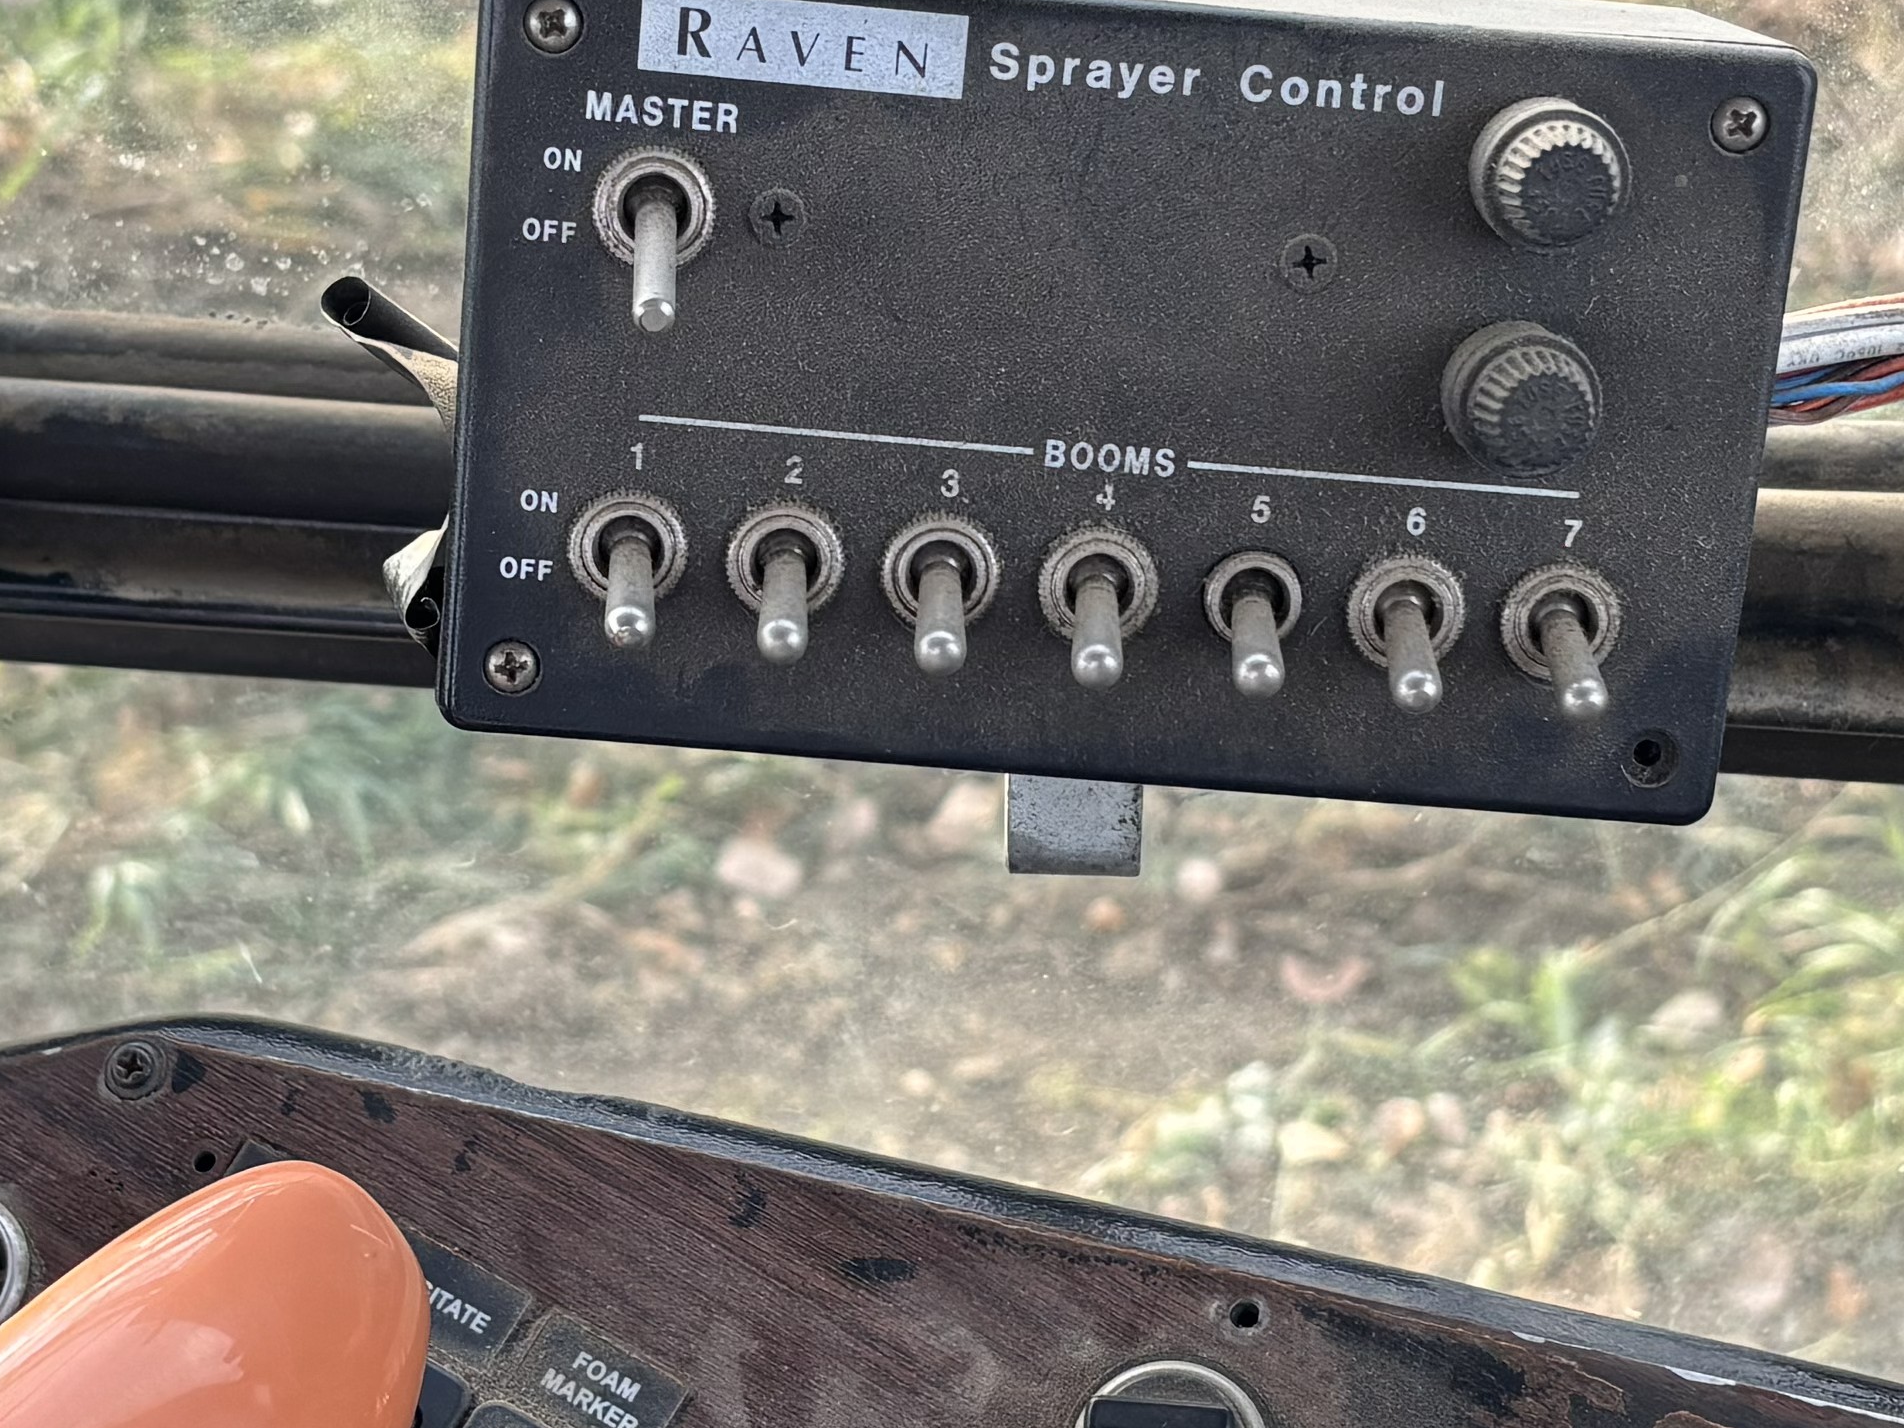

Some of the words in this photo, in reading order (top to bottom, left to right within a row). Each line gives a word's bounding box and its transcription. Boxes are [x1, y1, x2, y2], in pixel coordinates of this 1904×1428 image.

[676, 6, 930, 78] RAVEN
[989, 42, 1199, 99] Sprayer
[1239, 64, 1445, 117] Control
[585, 91, 738, 134] MASTER
[543, 147, 581, 171] ON
[521, 217, 577, 244] OFF
[1043, 438, 1176, 479] BOOMS
[519, 489, 558, 514] ON
[629, 444, 643, 471] 1
[784, 456, 803, 486] 2
[940, 469, 960, 498] 3
[1095, 485, 1115, 512] 4
[1250, 495, 1270, 523] 5
[1406, 506, 1426, 536] 6
[1563, 519, 1582, 548] 7
[499, 556, 552, 582] OFF
[572, 1351, 642, 1402] FOAM
